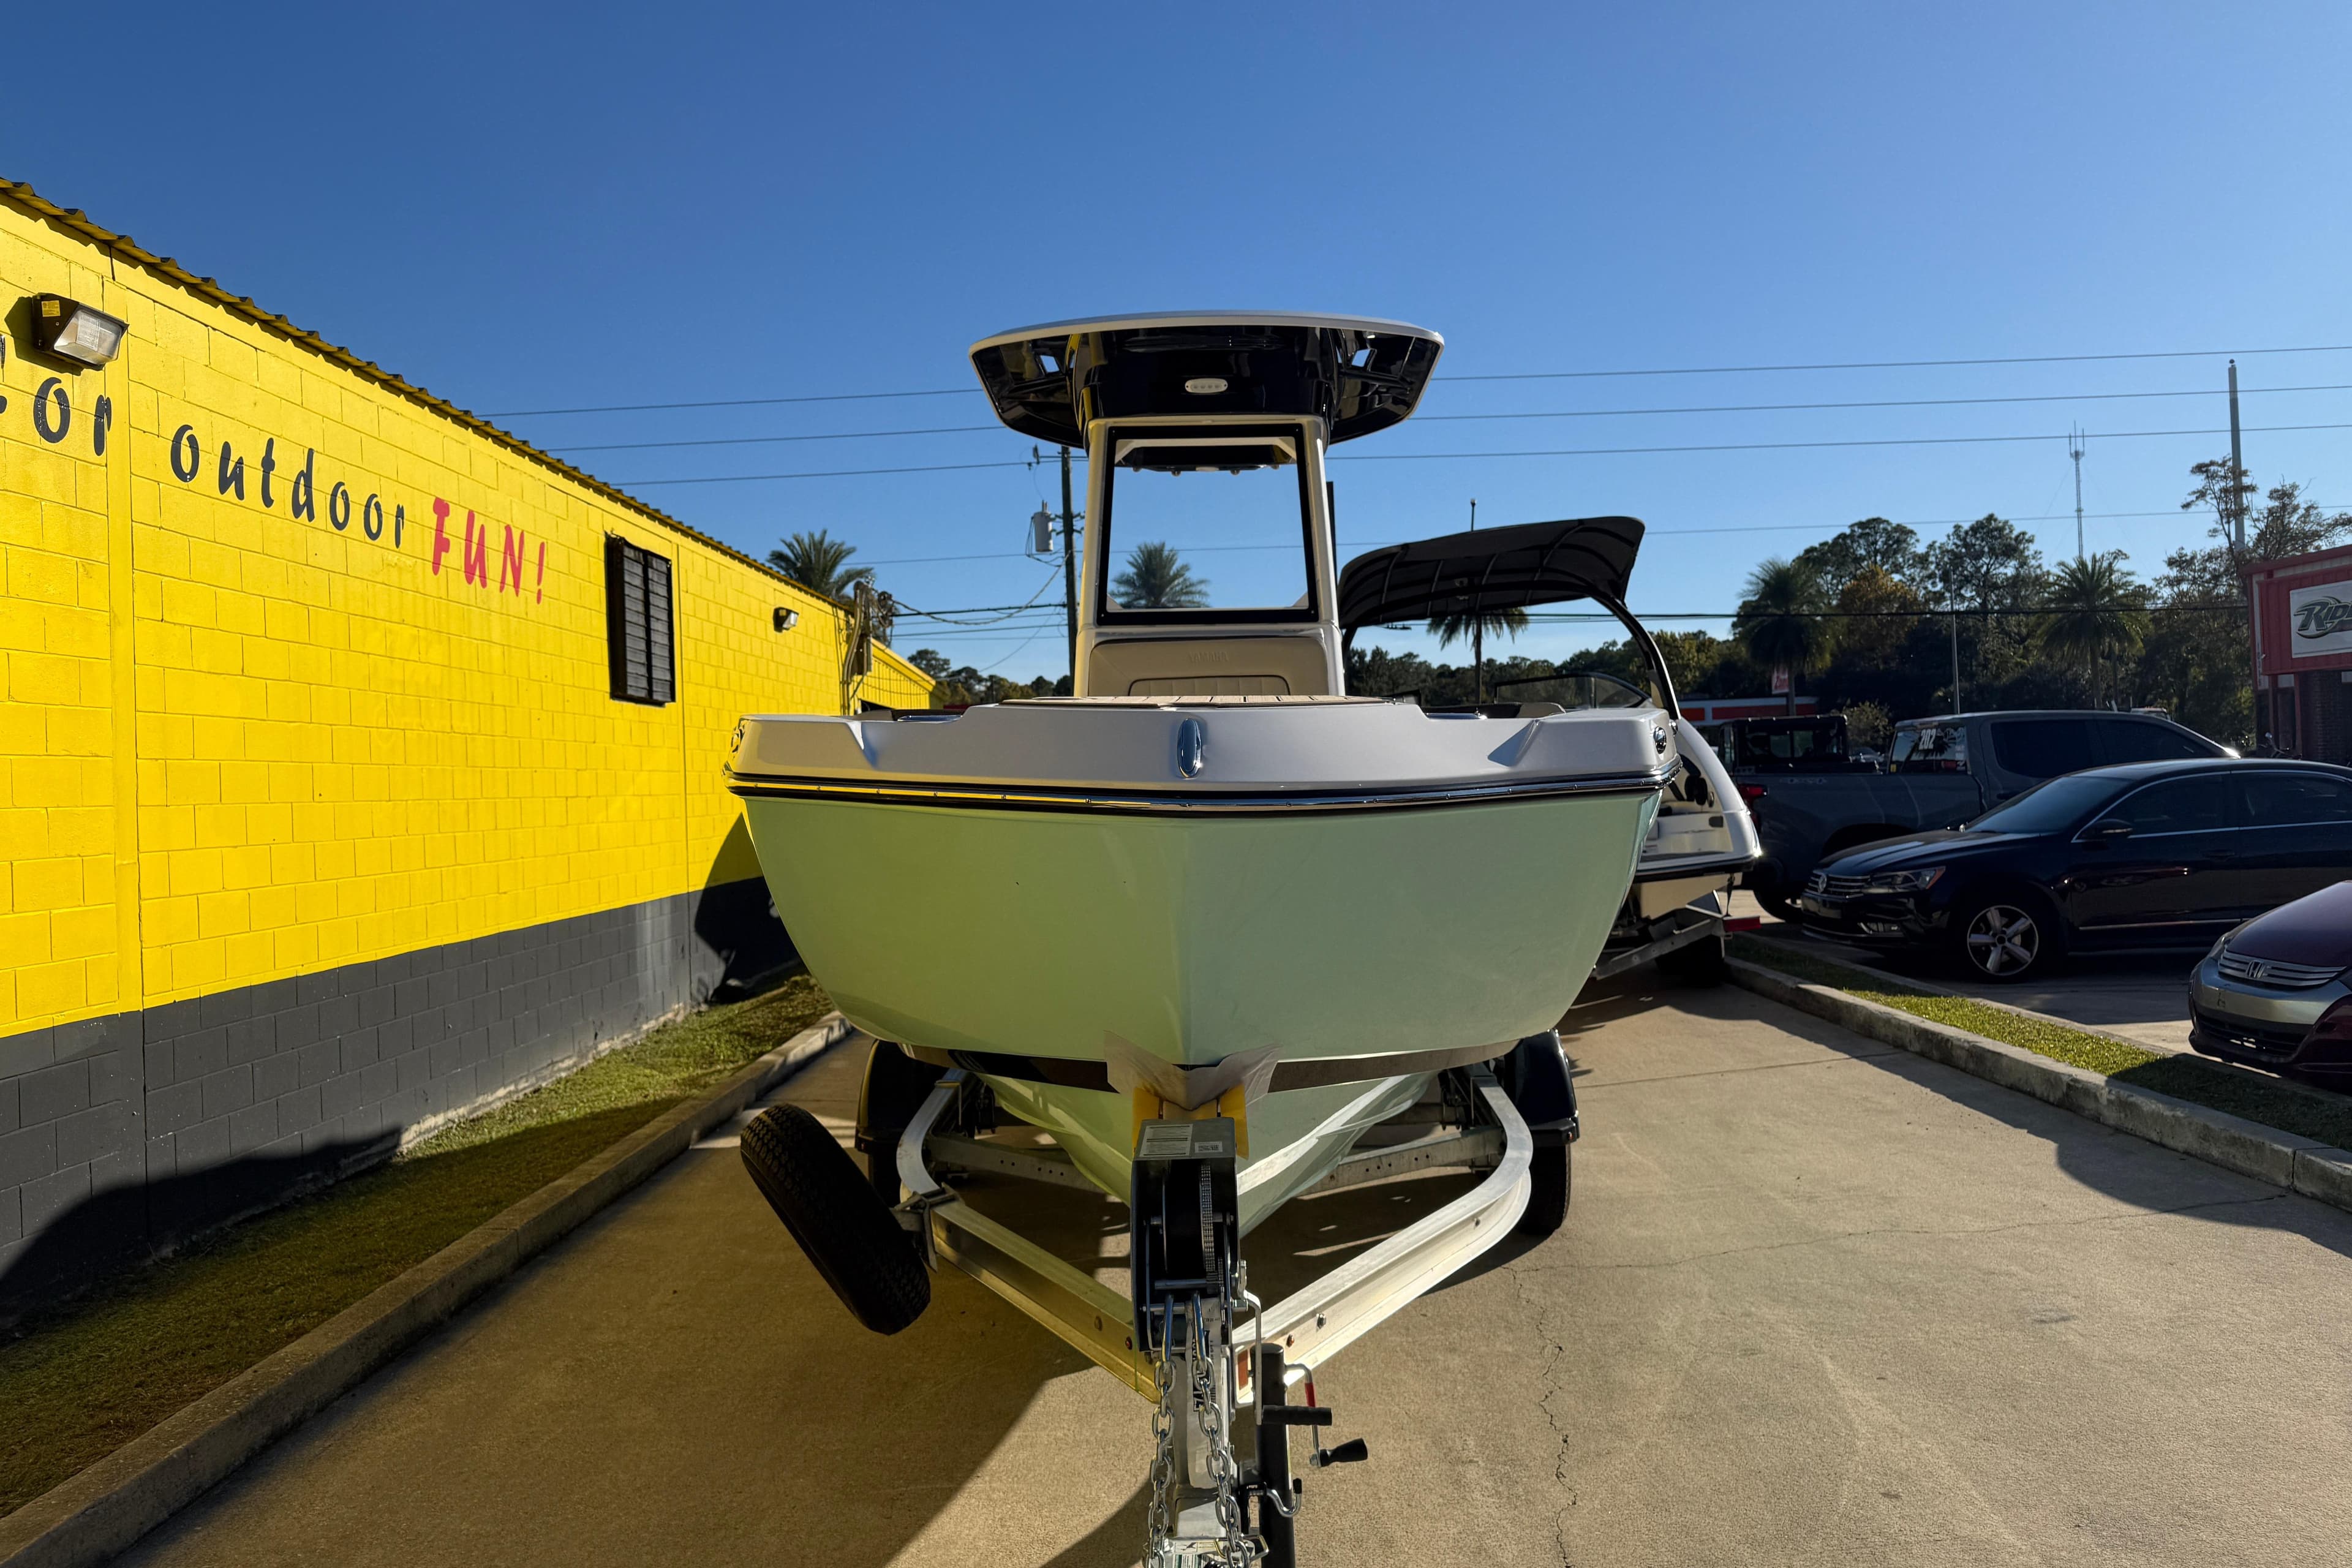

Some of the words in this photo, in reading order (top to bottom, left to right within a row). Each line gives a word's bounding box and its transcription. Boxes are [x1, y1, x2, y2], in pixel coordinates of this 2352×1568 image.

[171, 424, 404, 549] outdoor
[432, 497, 545, 605] FUN!
[1188, 651, 1229, 662] YAMAHA
